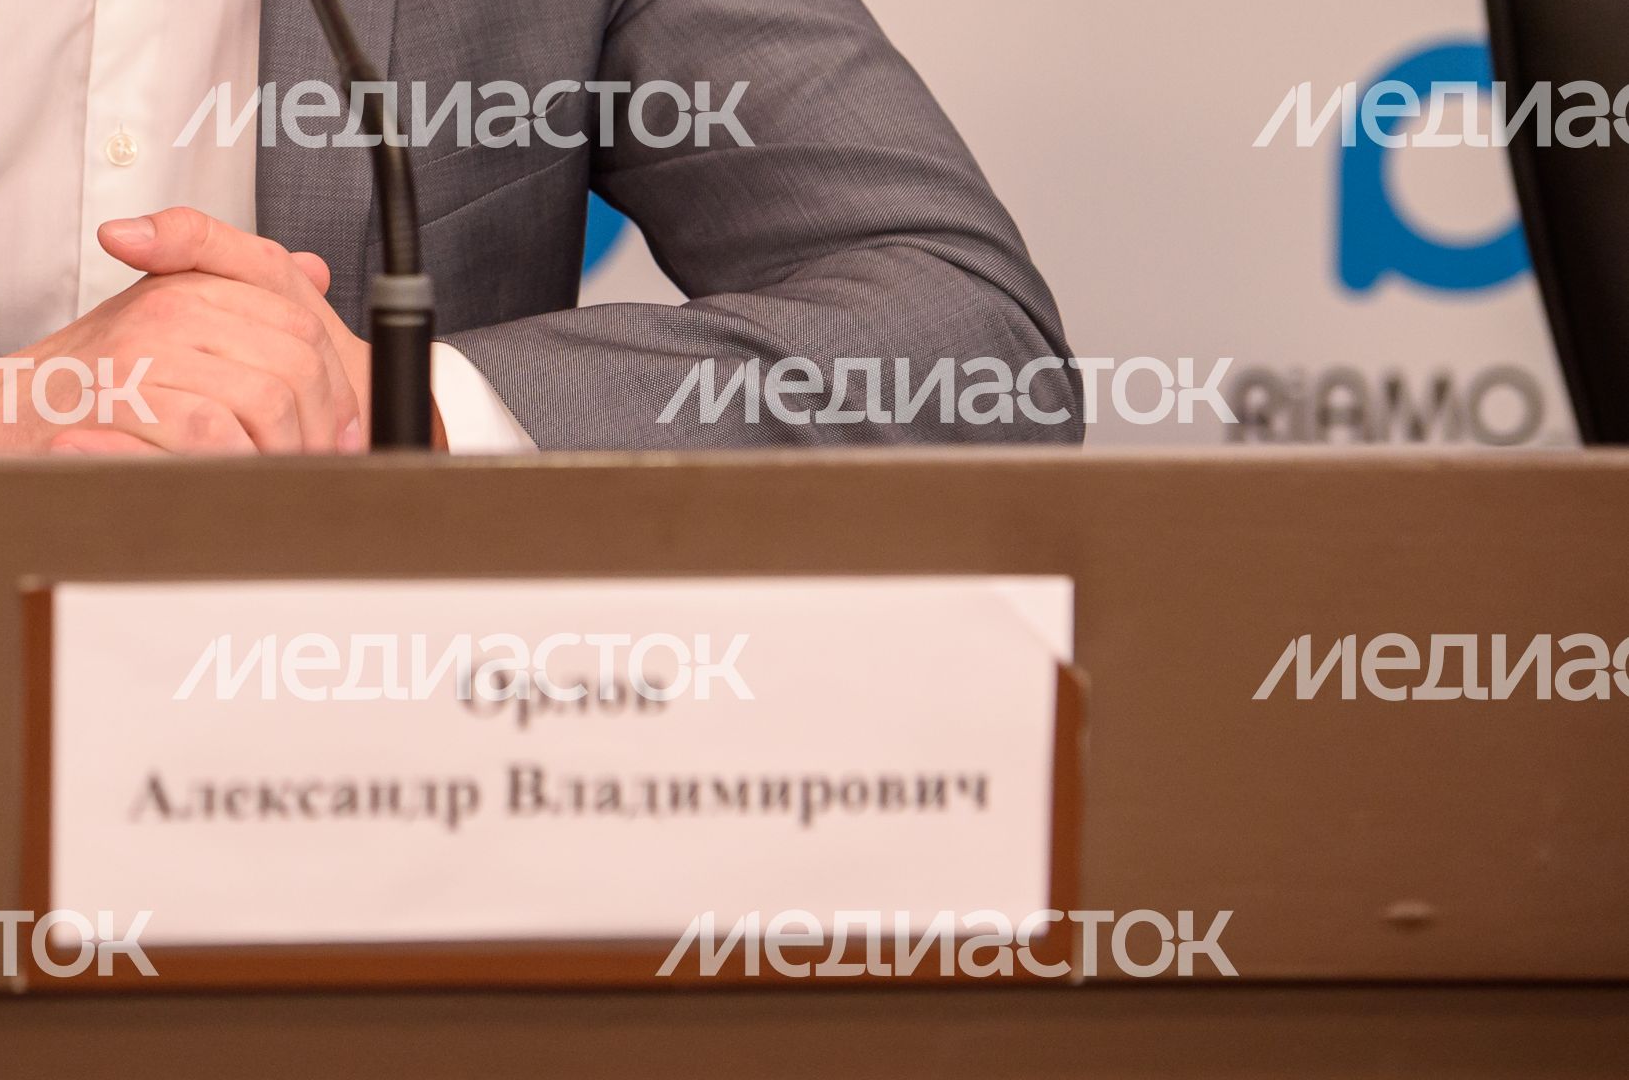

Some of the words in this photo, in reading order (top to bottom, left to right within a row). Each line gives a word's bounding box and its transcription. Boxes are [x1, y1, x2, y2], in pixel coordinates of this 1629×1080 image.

[456, 658, 671, 728] Орлов
[131, 768, 481, 829] Александр
[505, 762, 991, 828] Владимирович
